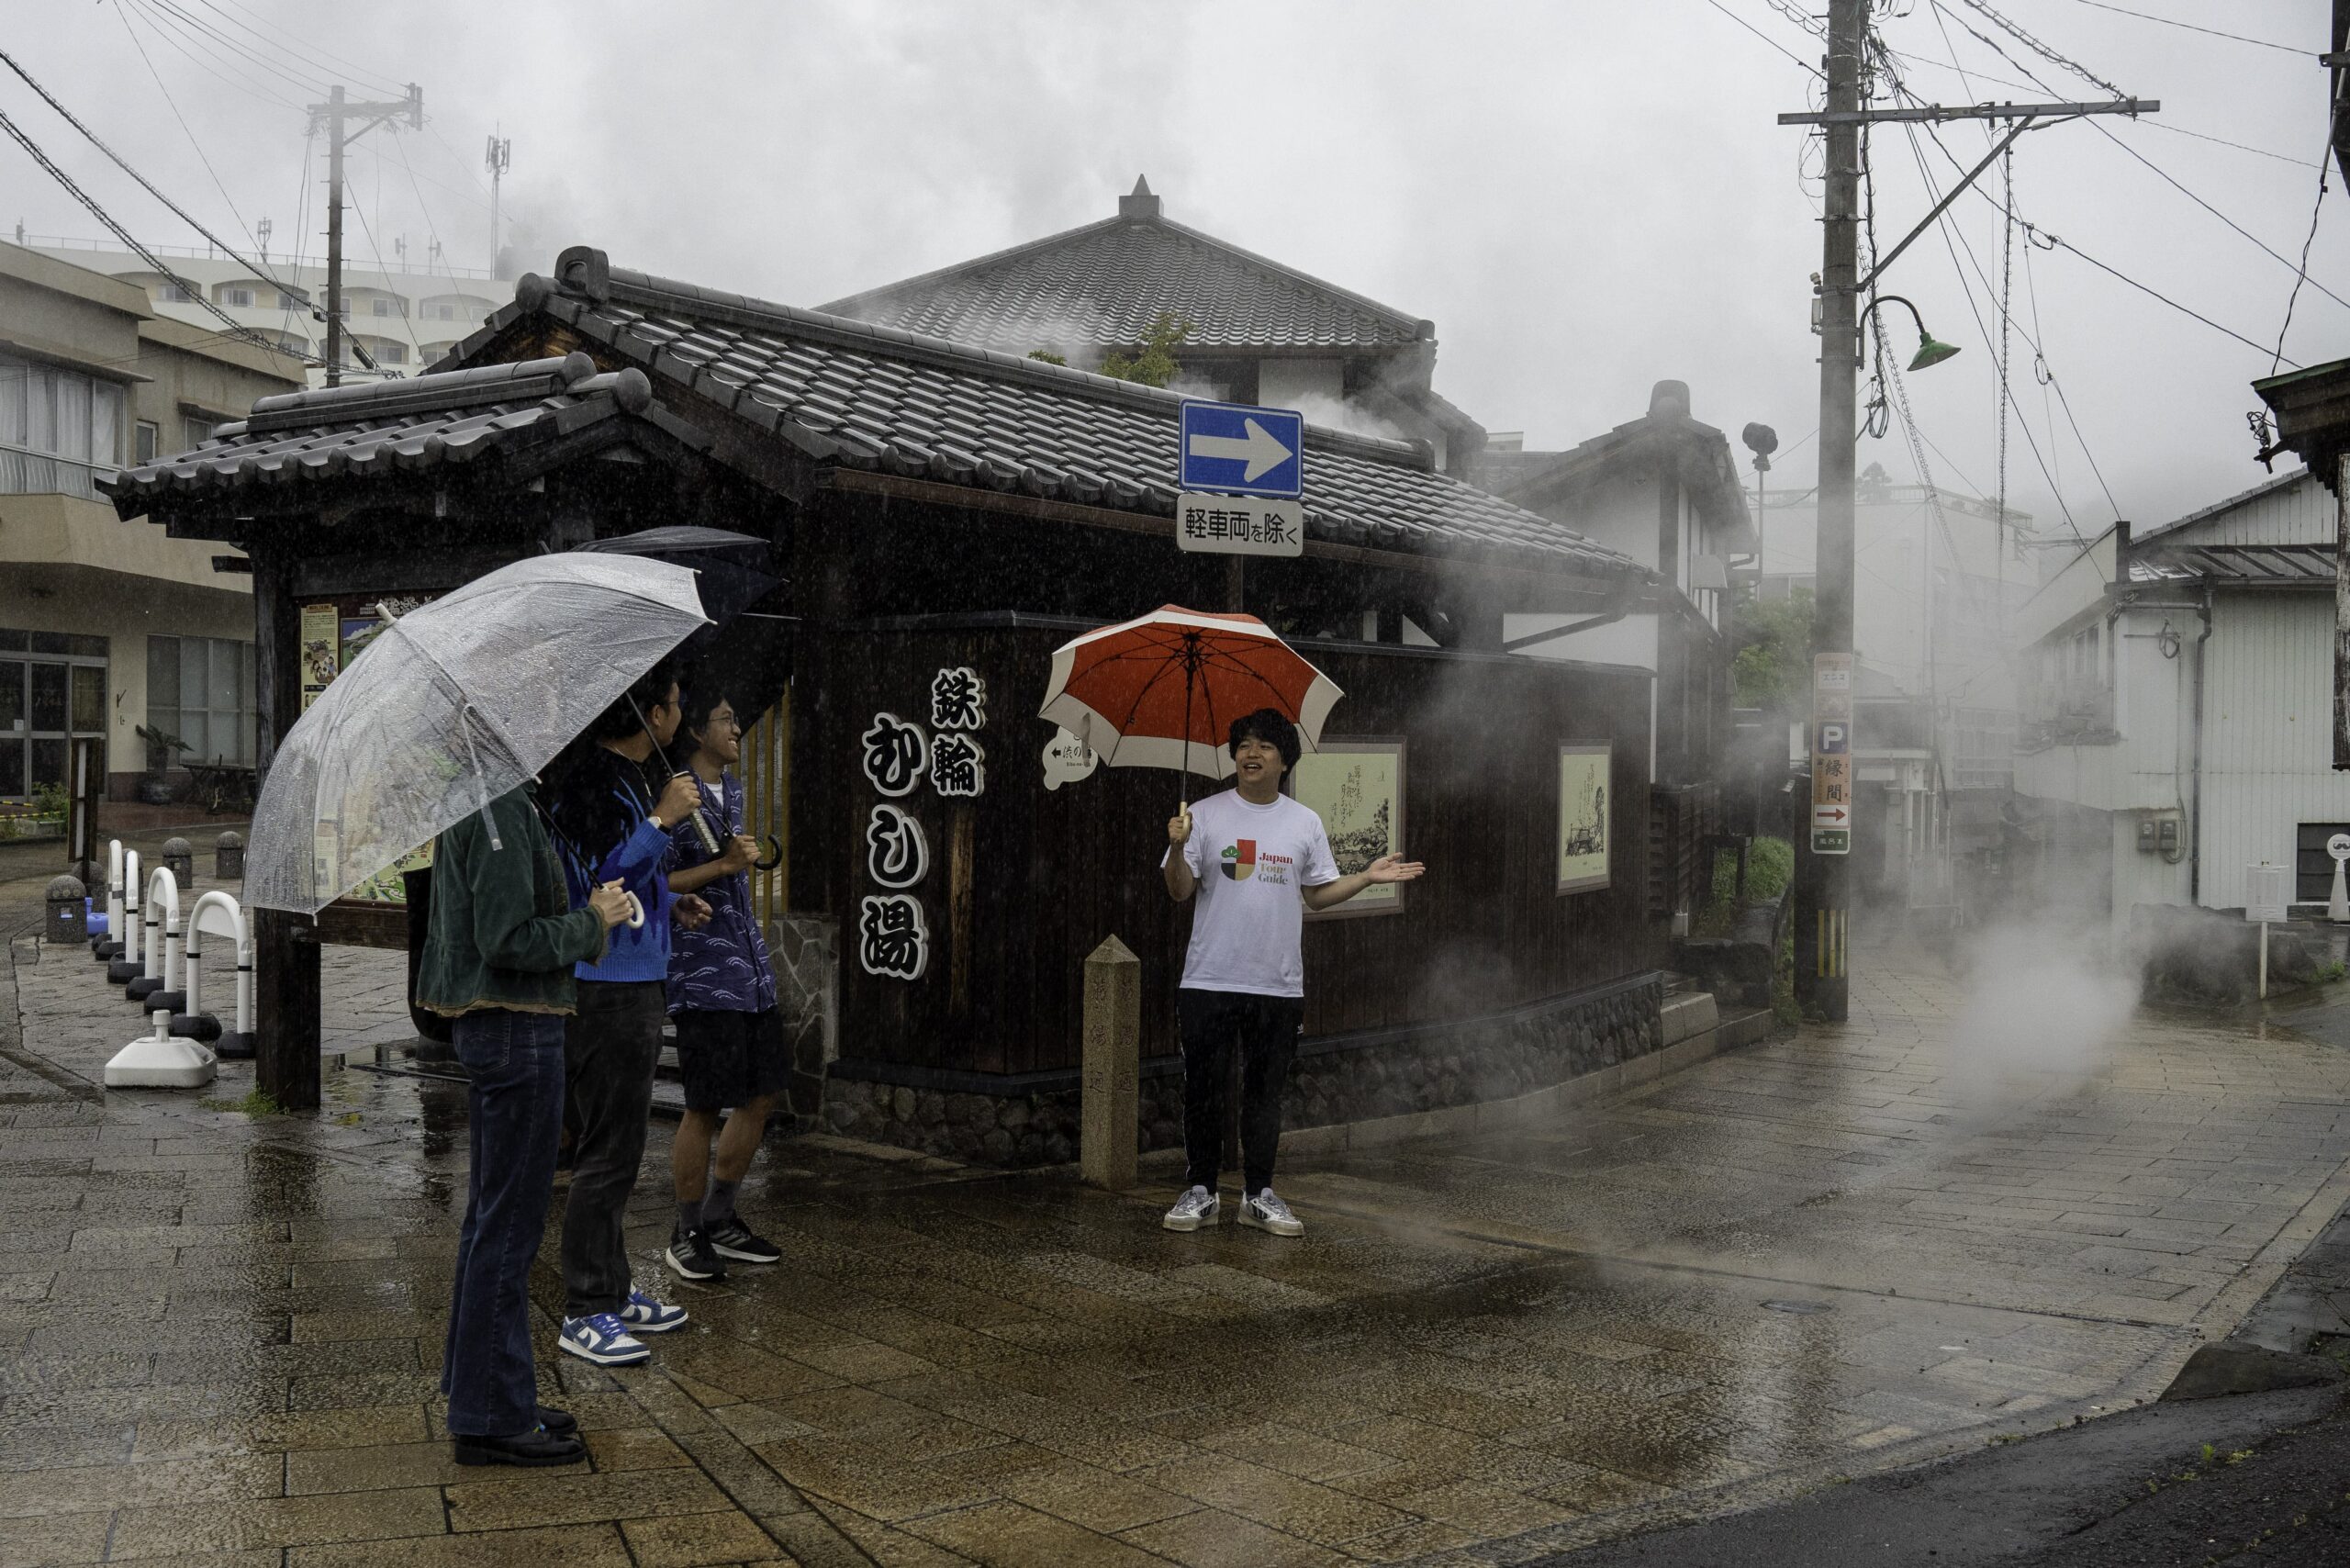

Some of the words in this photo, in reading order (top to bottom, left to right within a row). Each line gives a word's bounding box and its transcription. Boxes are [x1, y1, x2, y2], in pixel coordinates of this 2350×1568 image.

[1185, 507, 1297, 545] 軽車両を除く
[931, 666, 982, 797] 鉄輪
[1823, 725, 1843, 750] P
[860, 712, 926, 980] むし湯
[1259, 852, 1293, 865] Japan
[1258, 873, 1289, 885] Guide
[1260, 863, 1286, 874] Tour
